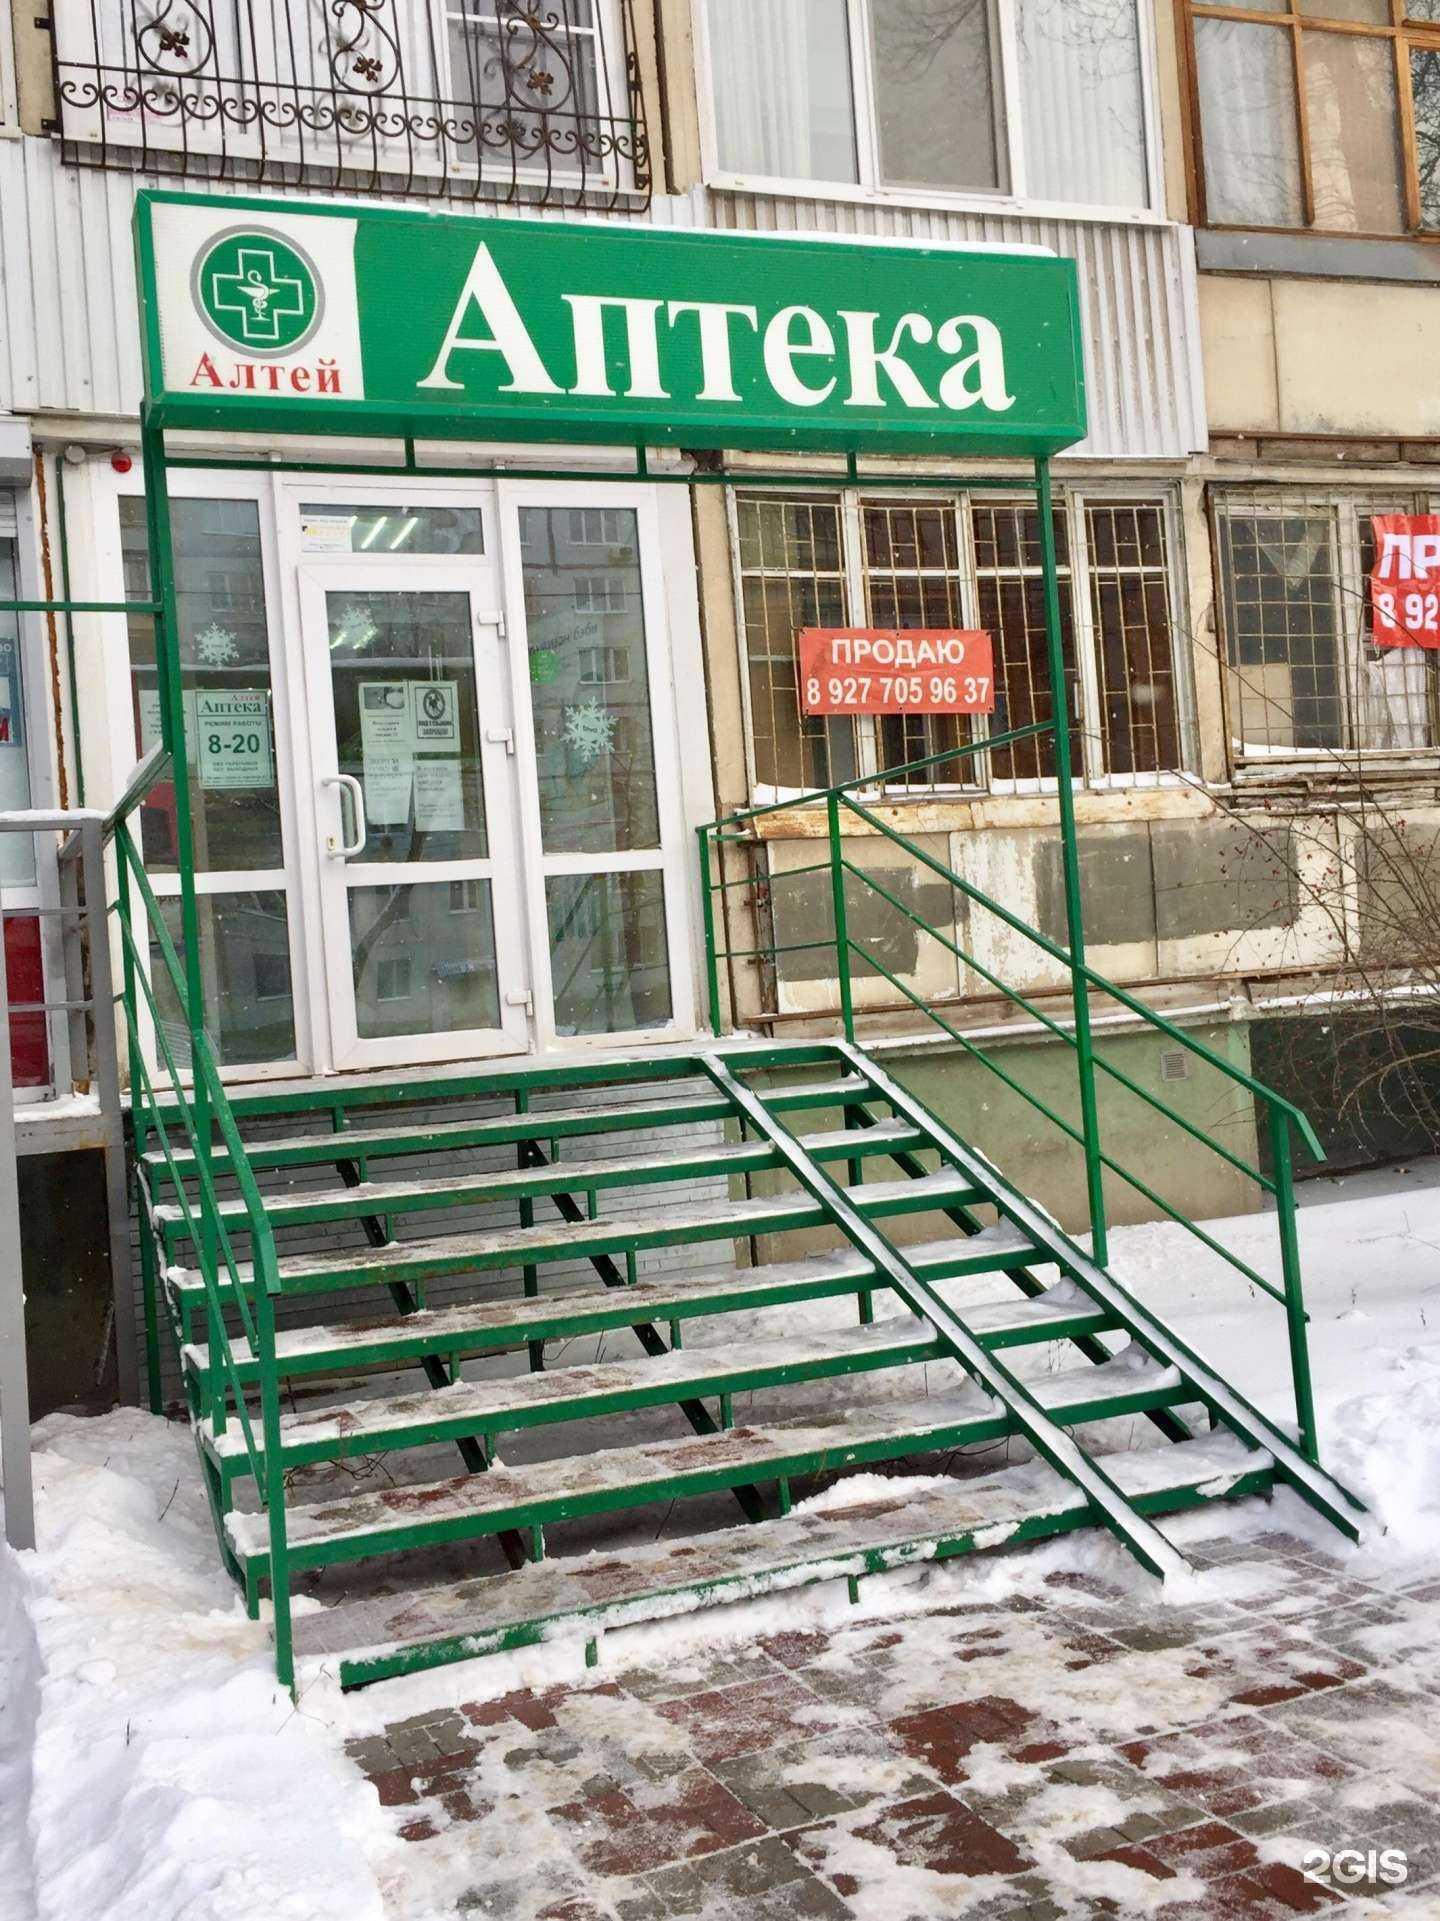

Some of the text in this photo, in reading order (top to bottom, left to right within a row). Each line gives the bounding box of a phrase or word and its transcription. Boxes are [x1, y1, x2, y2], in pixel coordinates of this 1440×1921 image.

[416, 241, 1016, 412] Аптека
[189, 351, 343, 394] Алтей
[1379, 593, 1397, 629] 8
[831, 638, 966, 669] ПРОДАЮ
[806, 676, 990, 705] 8 927 705 96 37
[201, 700, 262, 713] Аптека
[208, 734, 260, 754] 8-20
